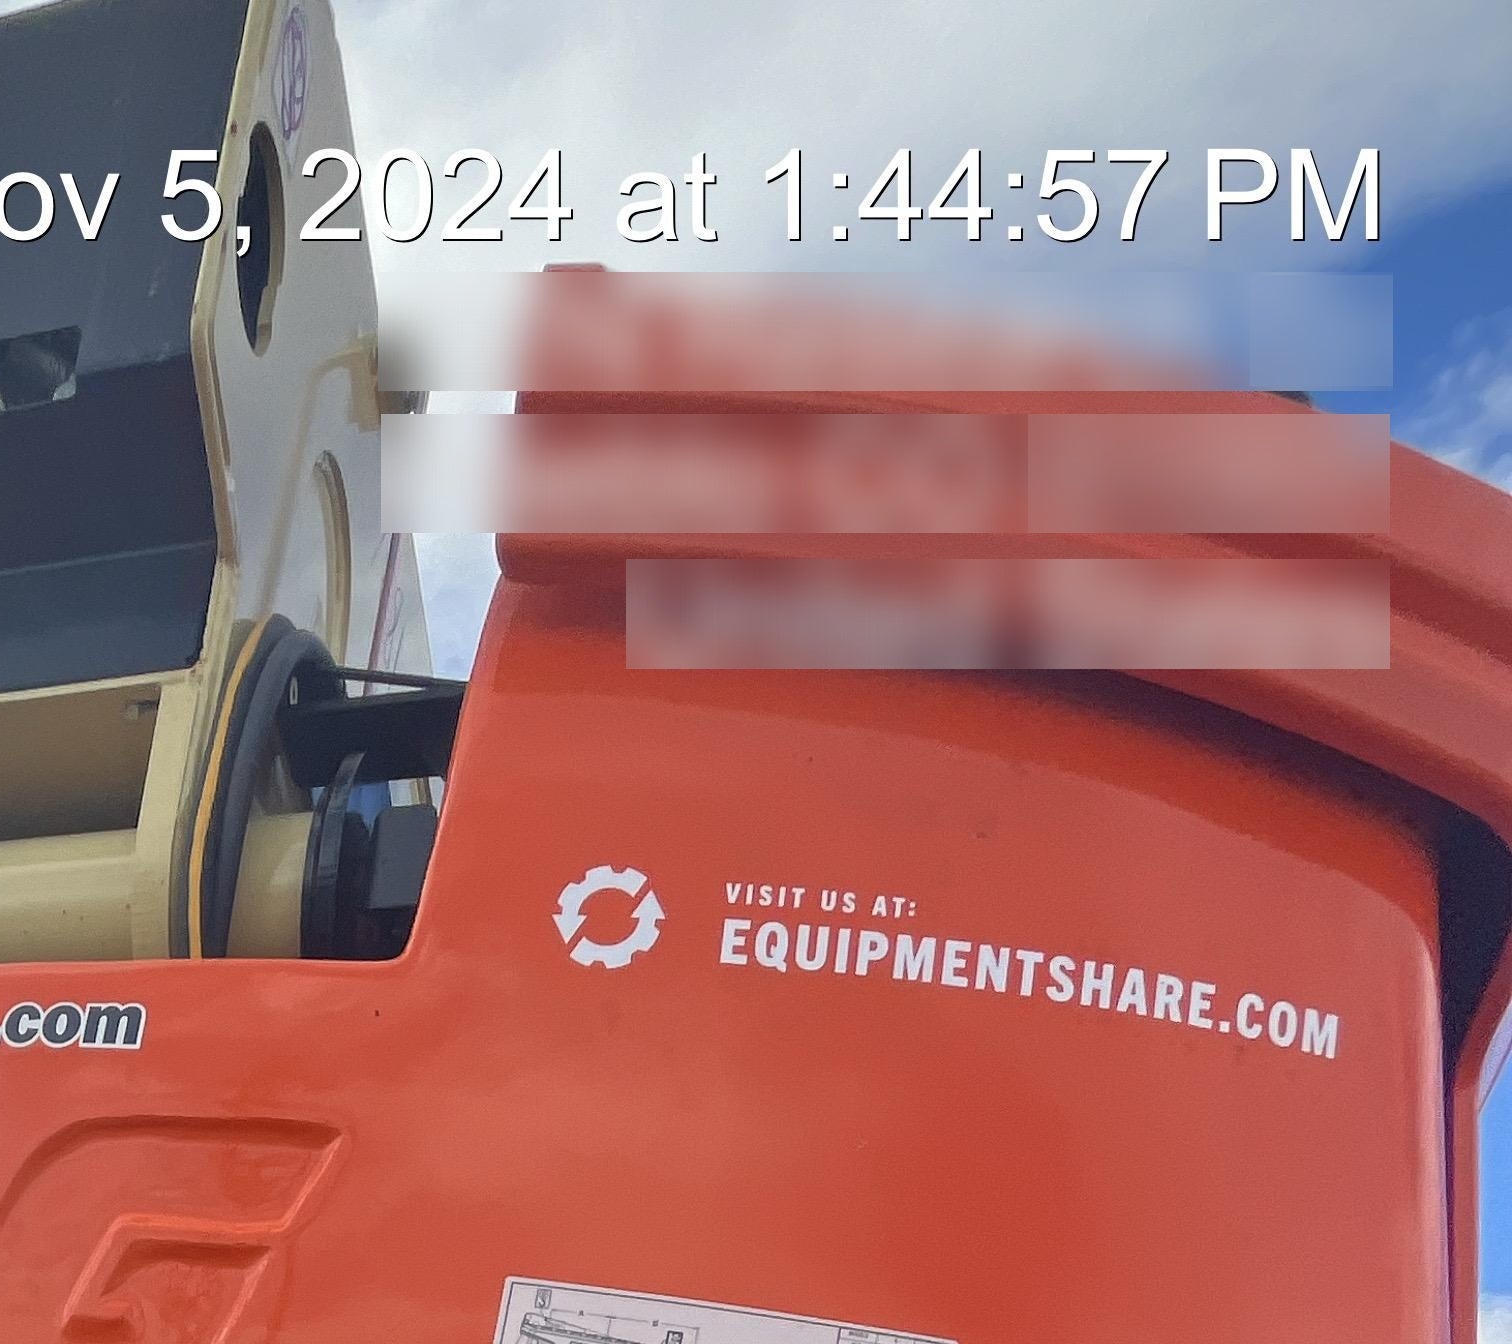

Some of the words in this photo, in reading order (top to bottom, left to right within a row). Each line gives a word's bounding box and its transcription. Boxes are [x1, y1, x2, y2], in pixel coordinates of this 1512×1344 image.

[725, 881, 806, 909] VISIT
[820, 888, 856, 914] US
[871, 894, 918, 919] AT:
[719, 917, 1340, 1060] EQUIPMENTSHARE.COM
